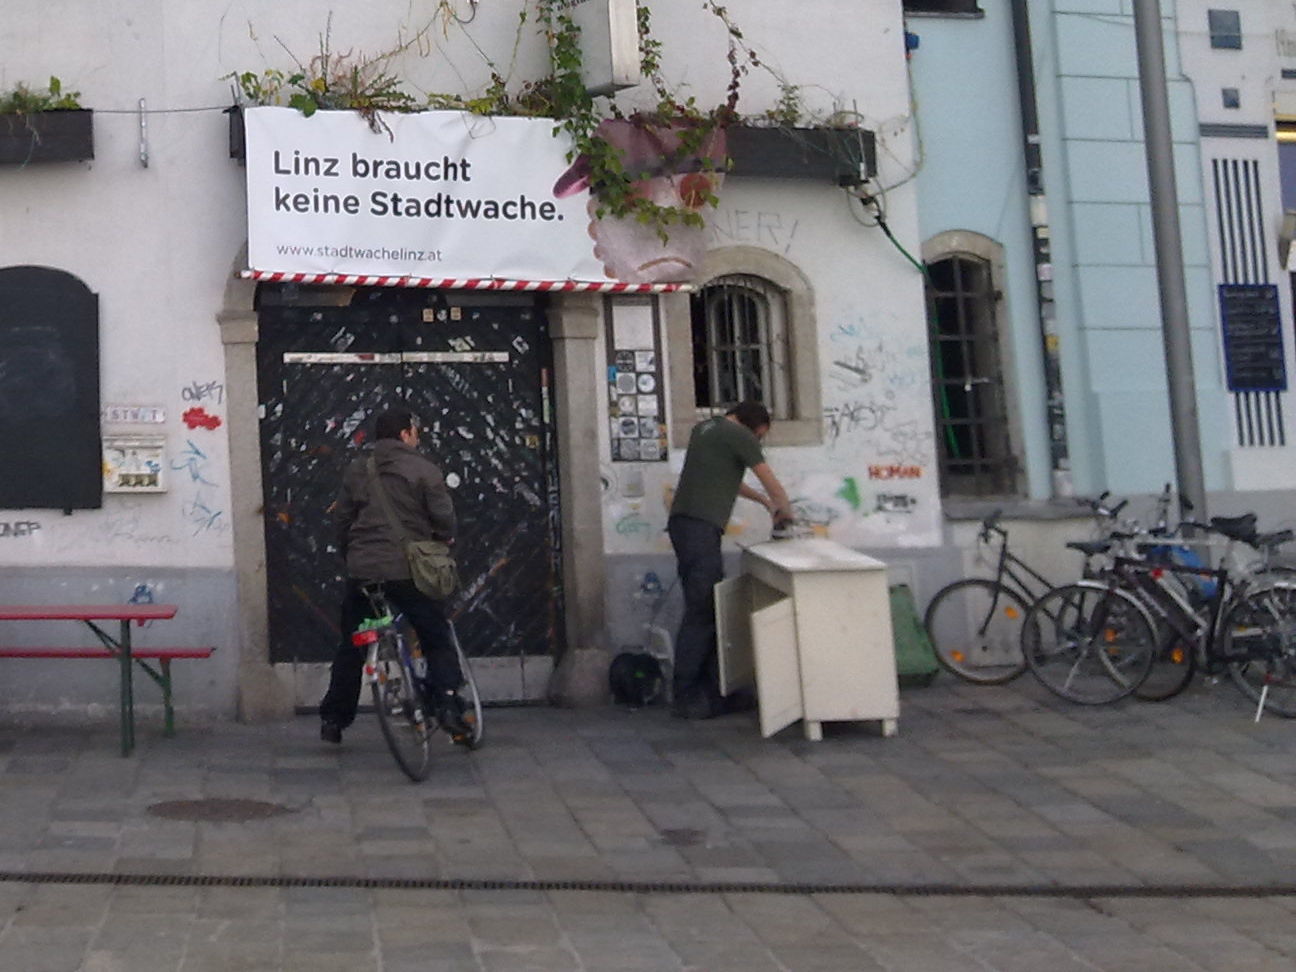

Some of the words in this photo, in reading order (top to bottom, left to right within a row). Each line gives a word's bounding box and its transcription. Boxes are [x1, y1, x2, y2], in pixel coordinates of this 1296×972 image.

[274, 150, 339, 177] Linz
[352, 152, 471, 182] braucht
[274, 186, 360, 214] keine
[370, 191, 564, 221] Stadtwache.
[277, 243, 442, 262] www.stadtwachelinz.at
